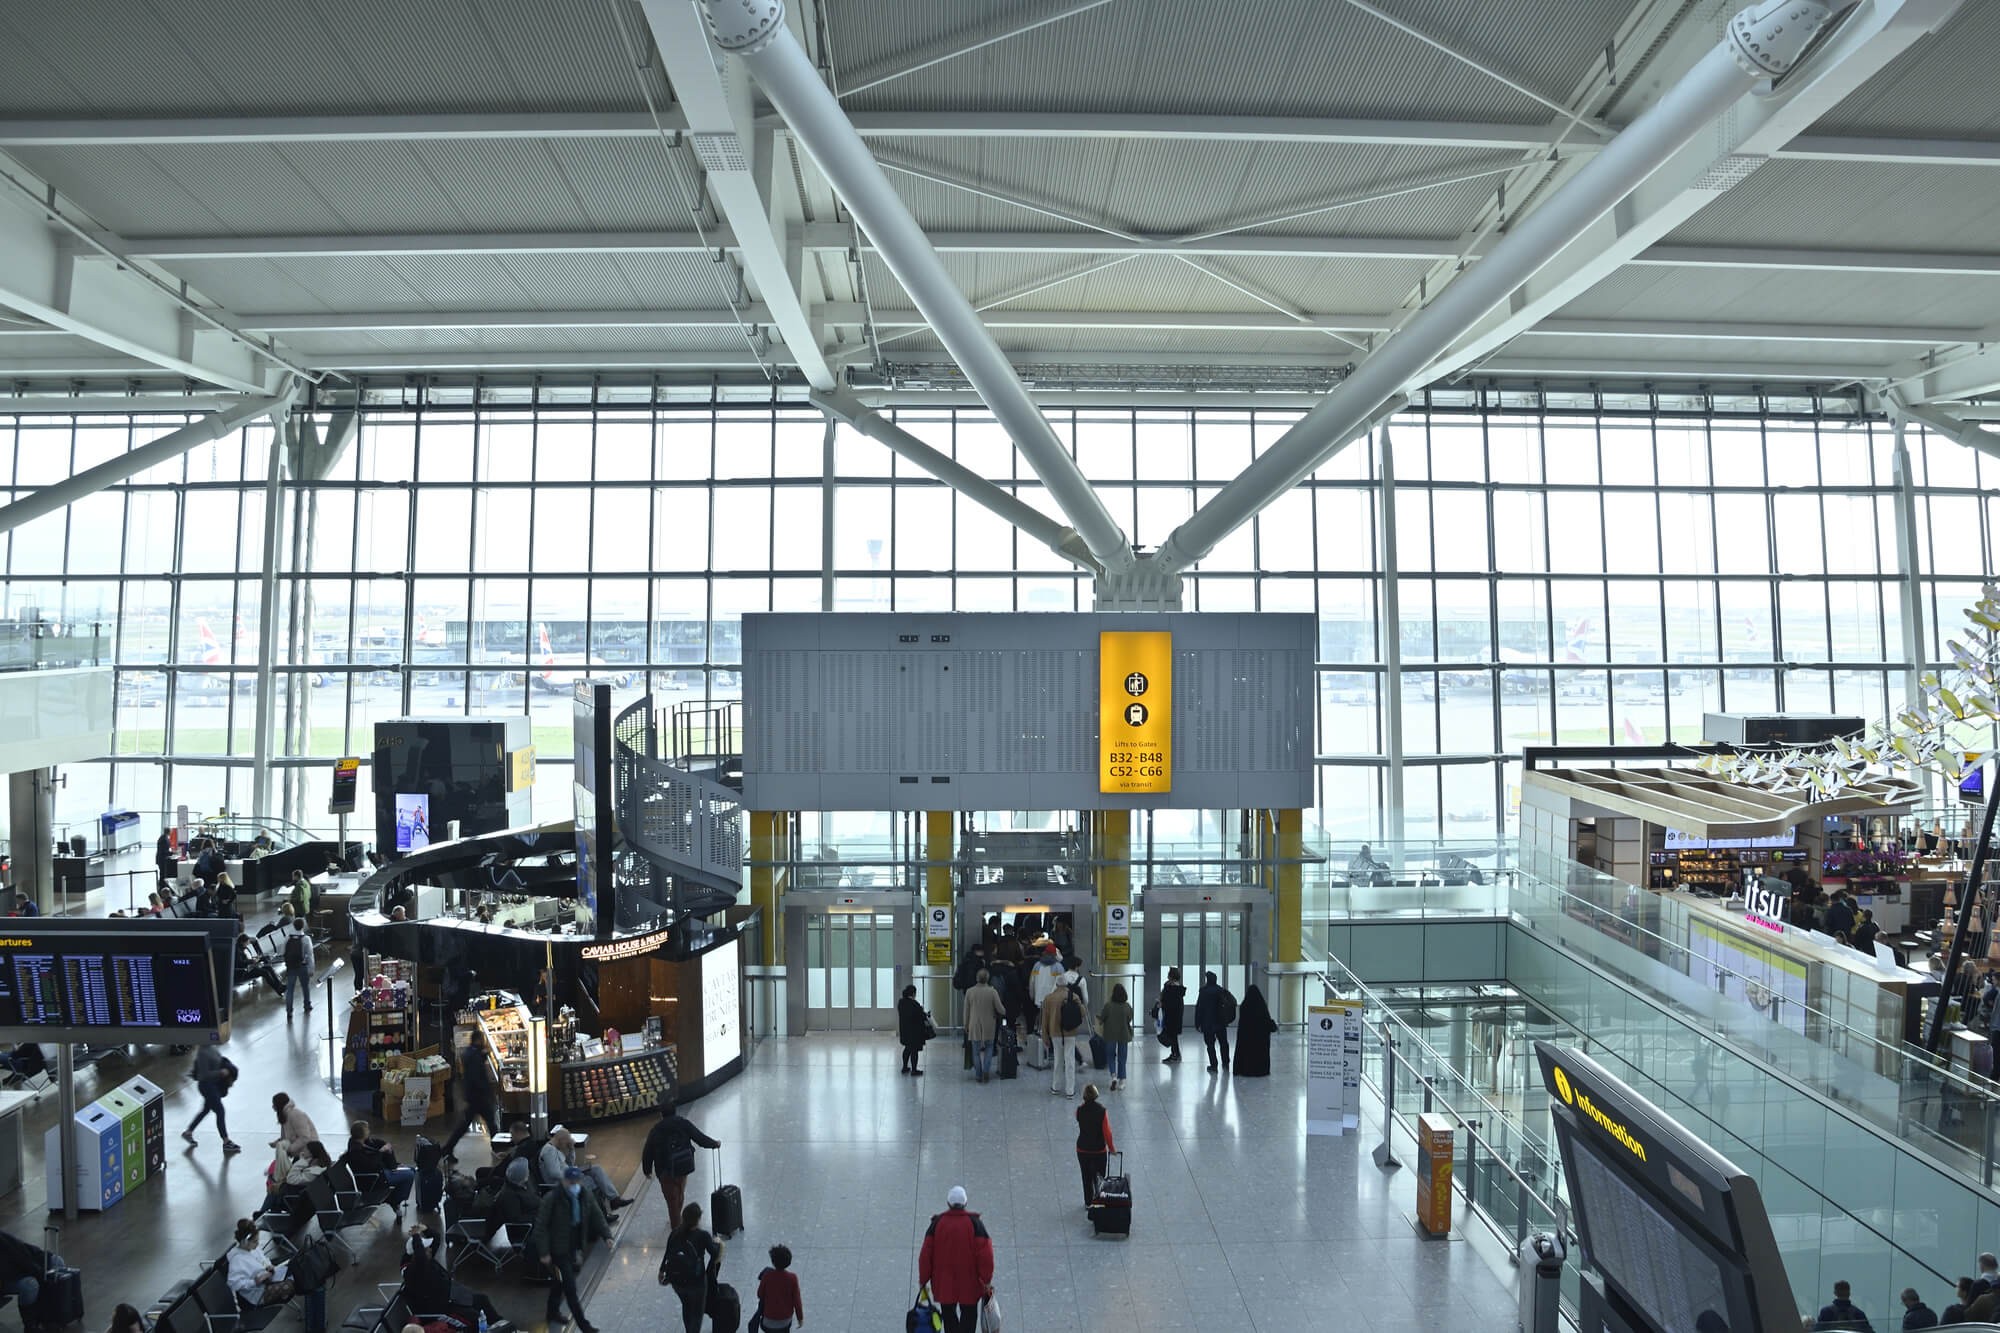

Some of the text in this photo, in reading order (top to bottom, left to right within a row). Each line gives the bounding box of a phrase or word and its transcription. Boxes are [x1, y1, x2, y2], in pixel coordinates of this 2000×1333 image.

[1110, 752, 1163, 763] B32-B48
[1110, 766, 1163, 777] C52-C66
[1744, 875, 1784, 921] itsu
[581, 945, 614, 956] CAVIAR
[615, 940, 640, 952] HOUSE
[640, 938, 646, 947] &
[177, 1014, 201, 1023] NOW
[590, 1091, 659, 1119] CAVIAR
[1574, 1087, 1647, 1162] Information
